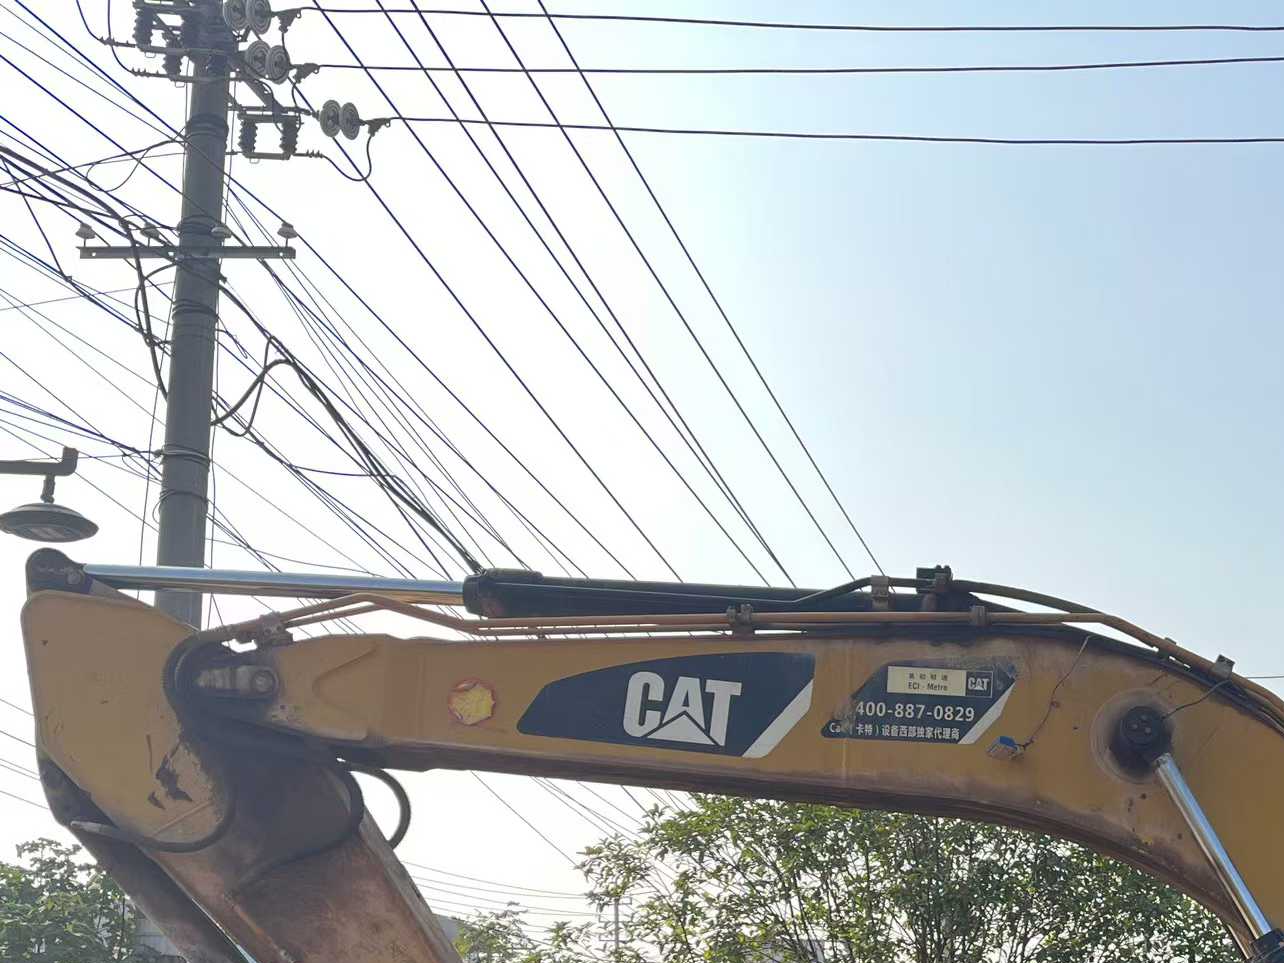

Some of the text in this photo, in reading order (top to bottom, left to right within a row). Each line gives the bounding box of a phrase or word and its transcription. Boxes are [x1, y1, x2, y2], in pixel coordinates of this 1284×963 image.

[967, 677, 990, 691] CAT
[623, 671, 742, 747] CAT
[855, 701, 975, 722] 400-887-0829
